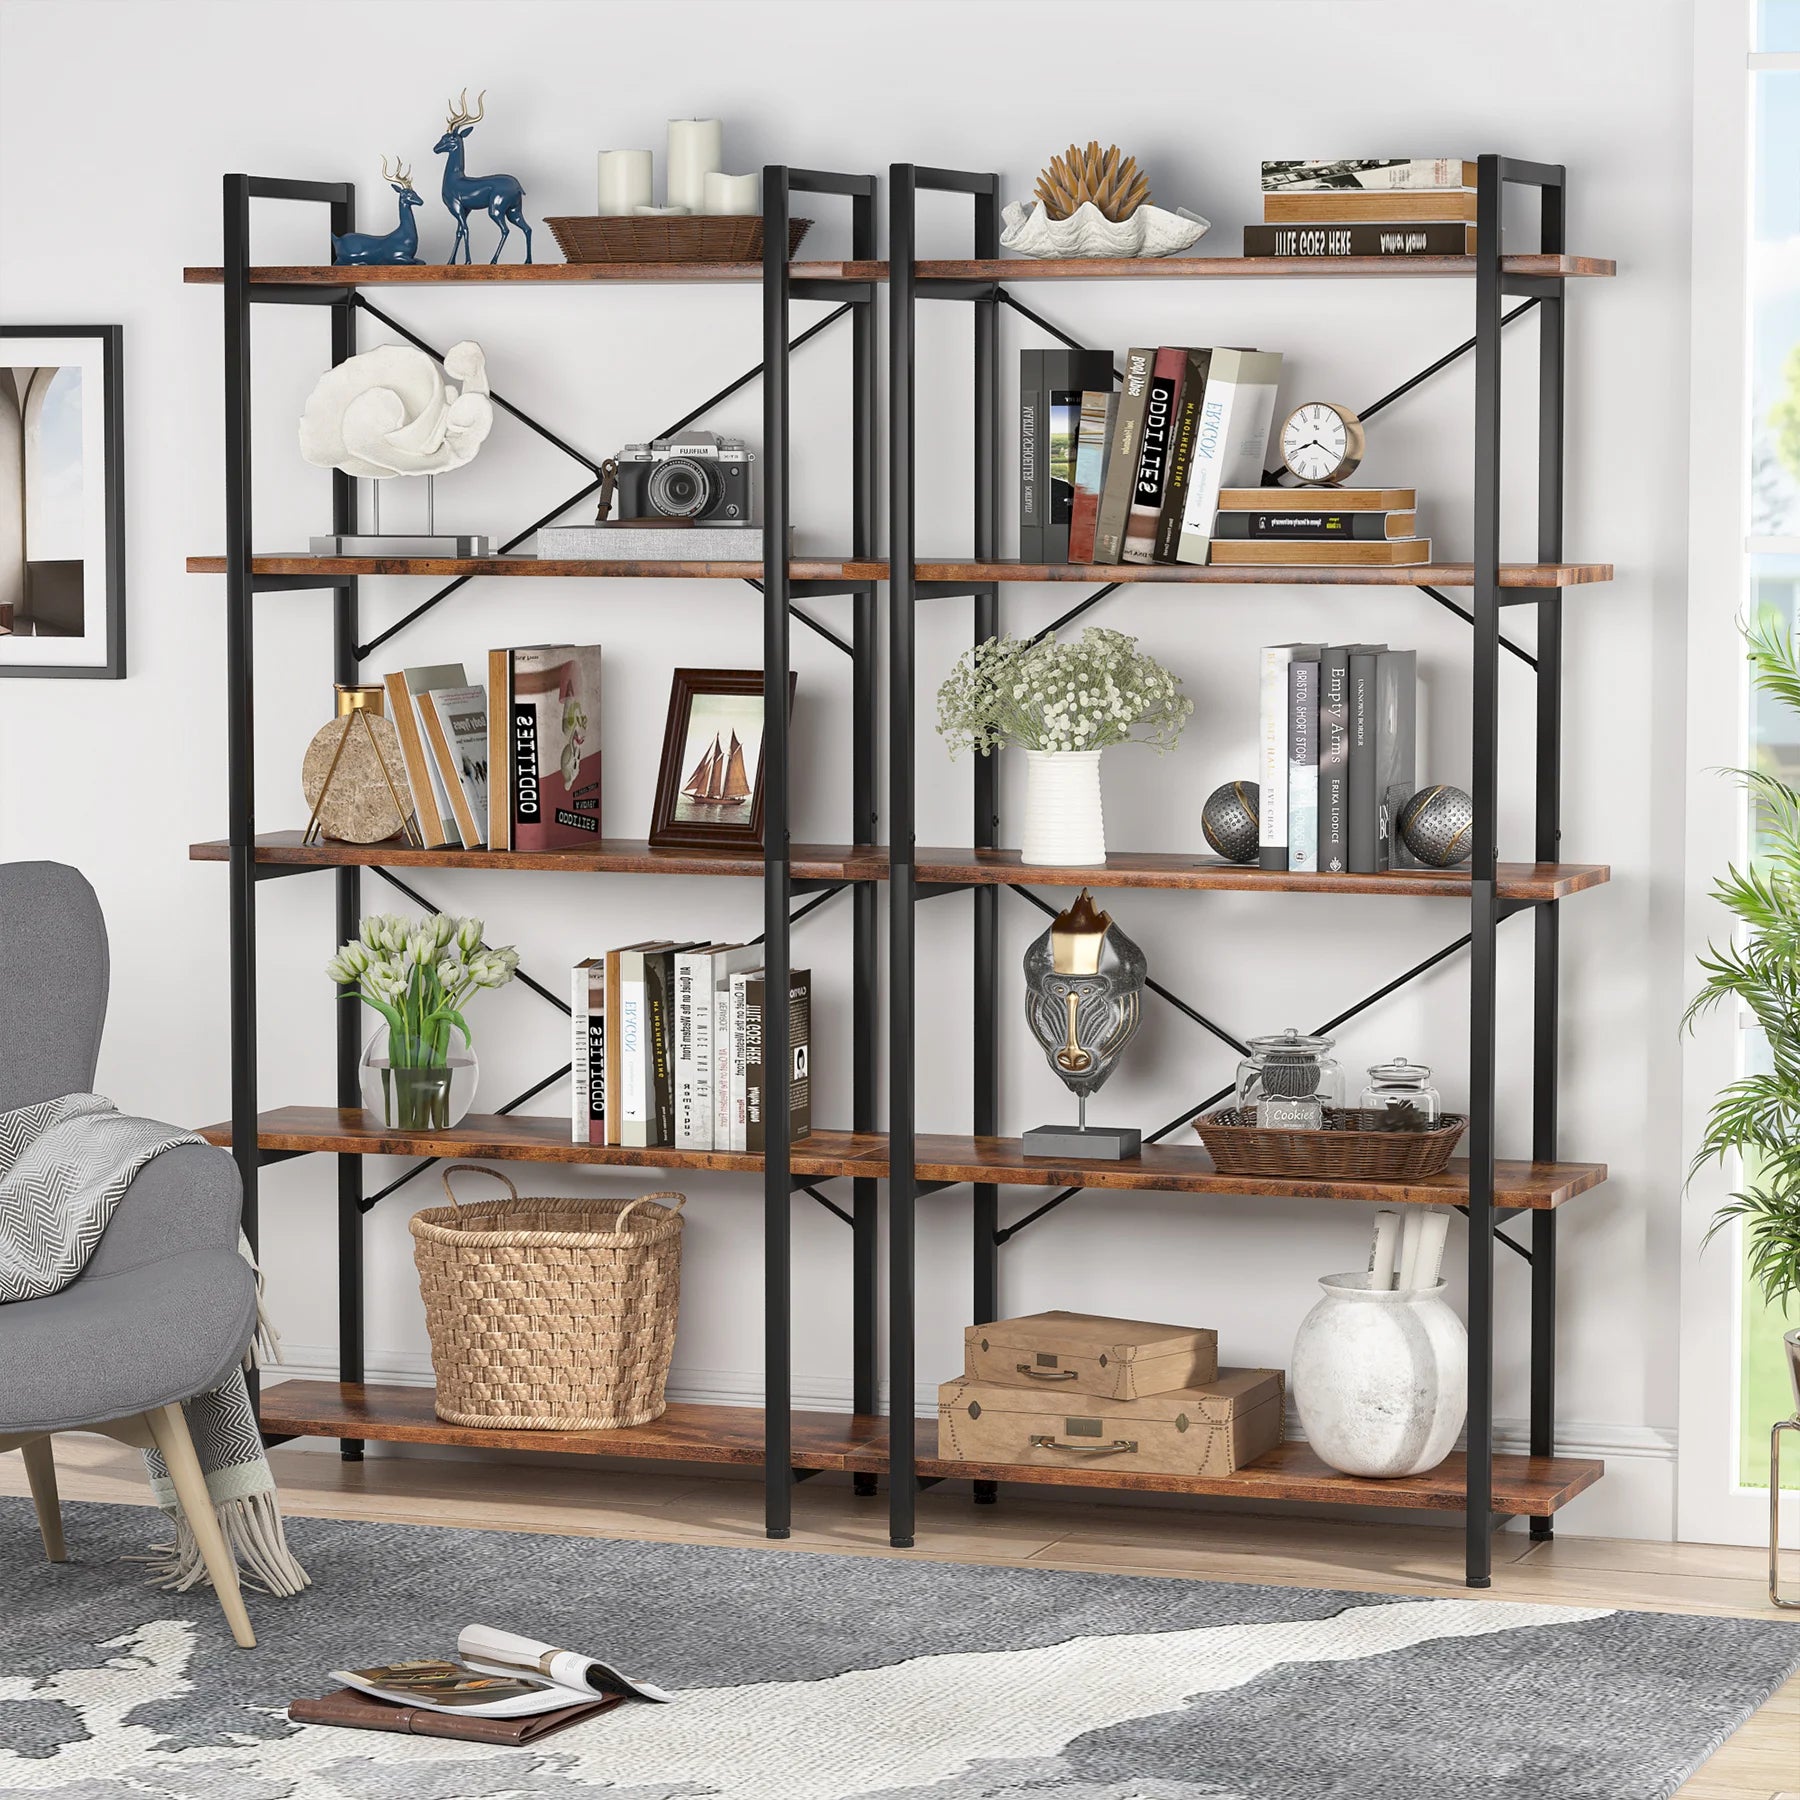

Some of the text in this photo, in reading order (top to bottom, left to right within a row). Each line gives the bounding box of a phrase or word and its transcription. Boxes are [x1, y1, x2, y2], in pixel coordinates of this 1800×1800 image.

[1296, 670, 1307, 703] BRISTOL
[1296, 706, 1307, 735] SHORT
[1328, 668, 1345, 763] Empty Arms
[1331, 779, 1340, 844] ERIKA LIODICE
[1273, 1108, 1315, 1121] Cookies
